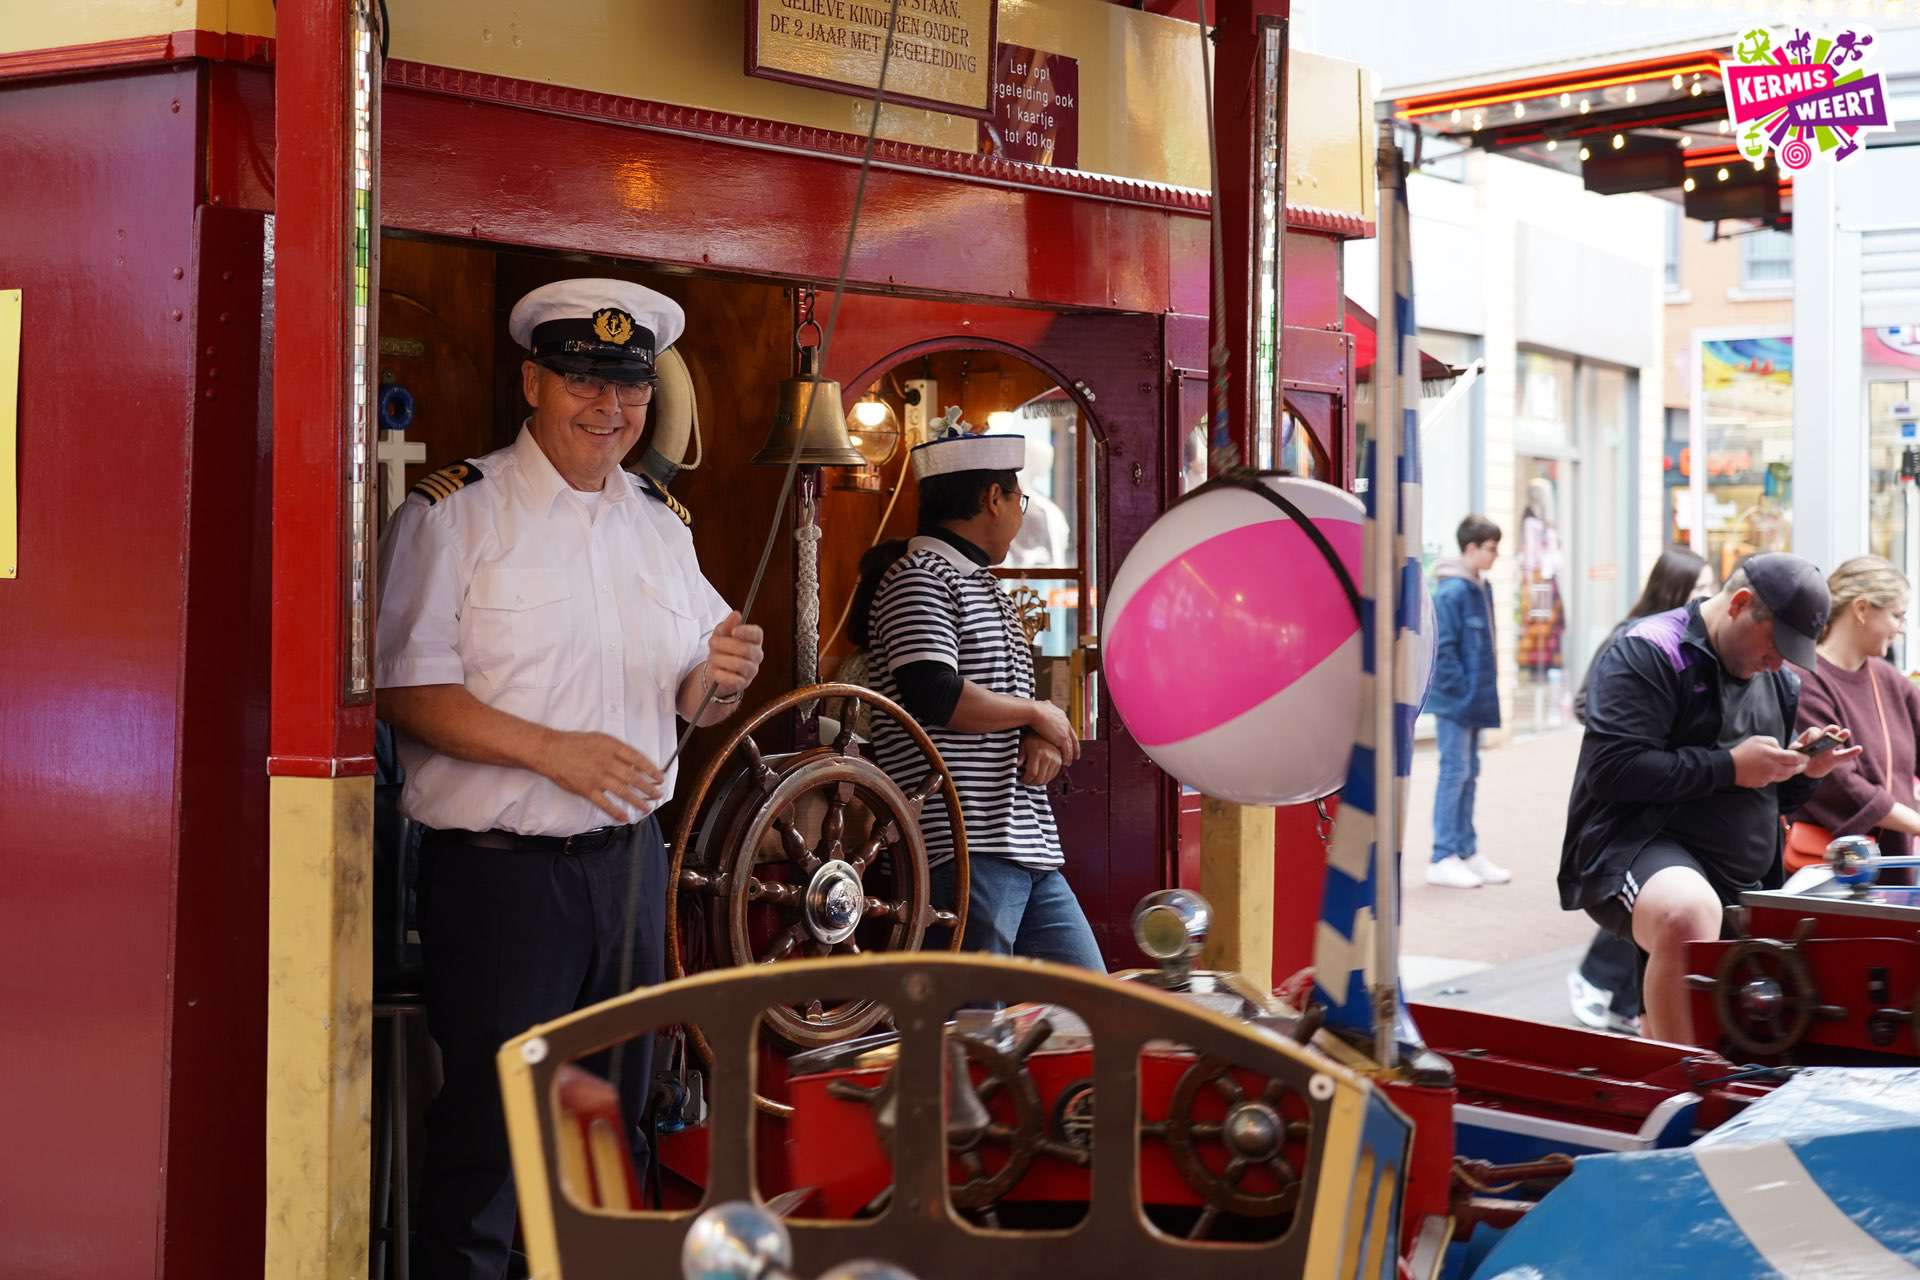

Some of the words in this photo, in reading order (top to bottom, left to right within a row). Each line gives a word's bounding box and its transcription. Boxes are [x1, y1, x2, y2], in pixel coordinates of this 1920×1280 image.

[849, 4, 920, 35] KINDEREN
[923, 20, 969, 47] ONDER
[770, 13, 790, 35] DE
[794, 18, 803, 37] 2
[806, 22, 847, 48] JAAR
[850, 30, 882, 53] MET
[885, 38, 977, 73] BEGELEIDING
[1010, 58, 1027, 76] Let
[1055, 94, 1074, 108] ook
[1006, 103, 1011, 119] 1
[1017, 106, 1054, 130] kaartje
[1005, 127, 1020, 144] tot
[1026, 130, 1038, 147] 80
